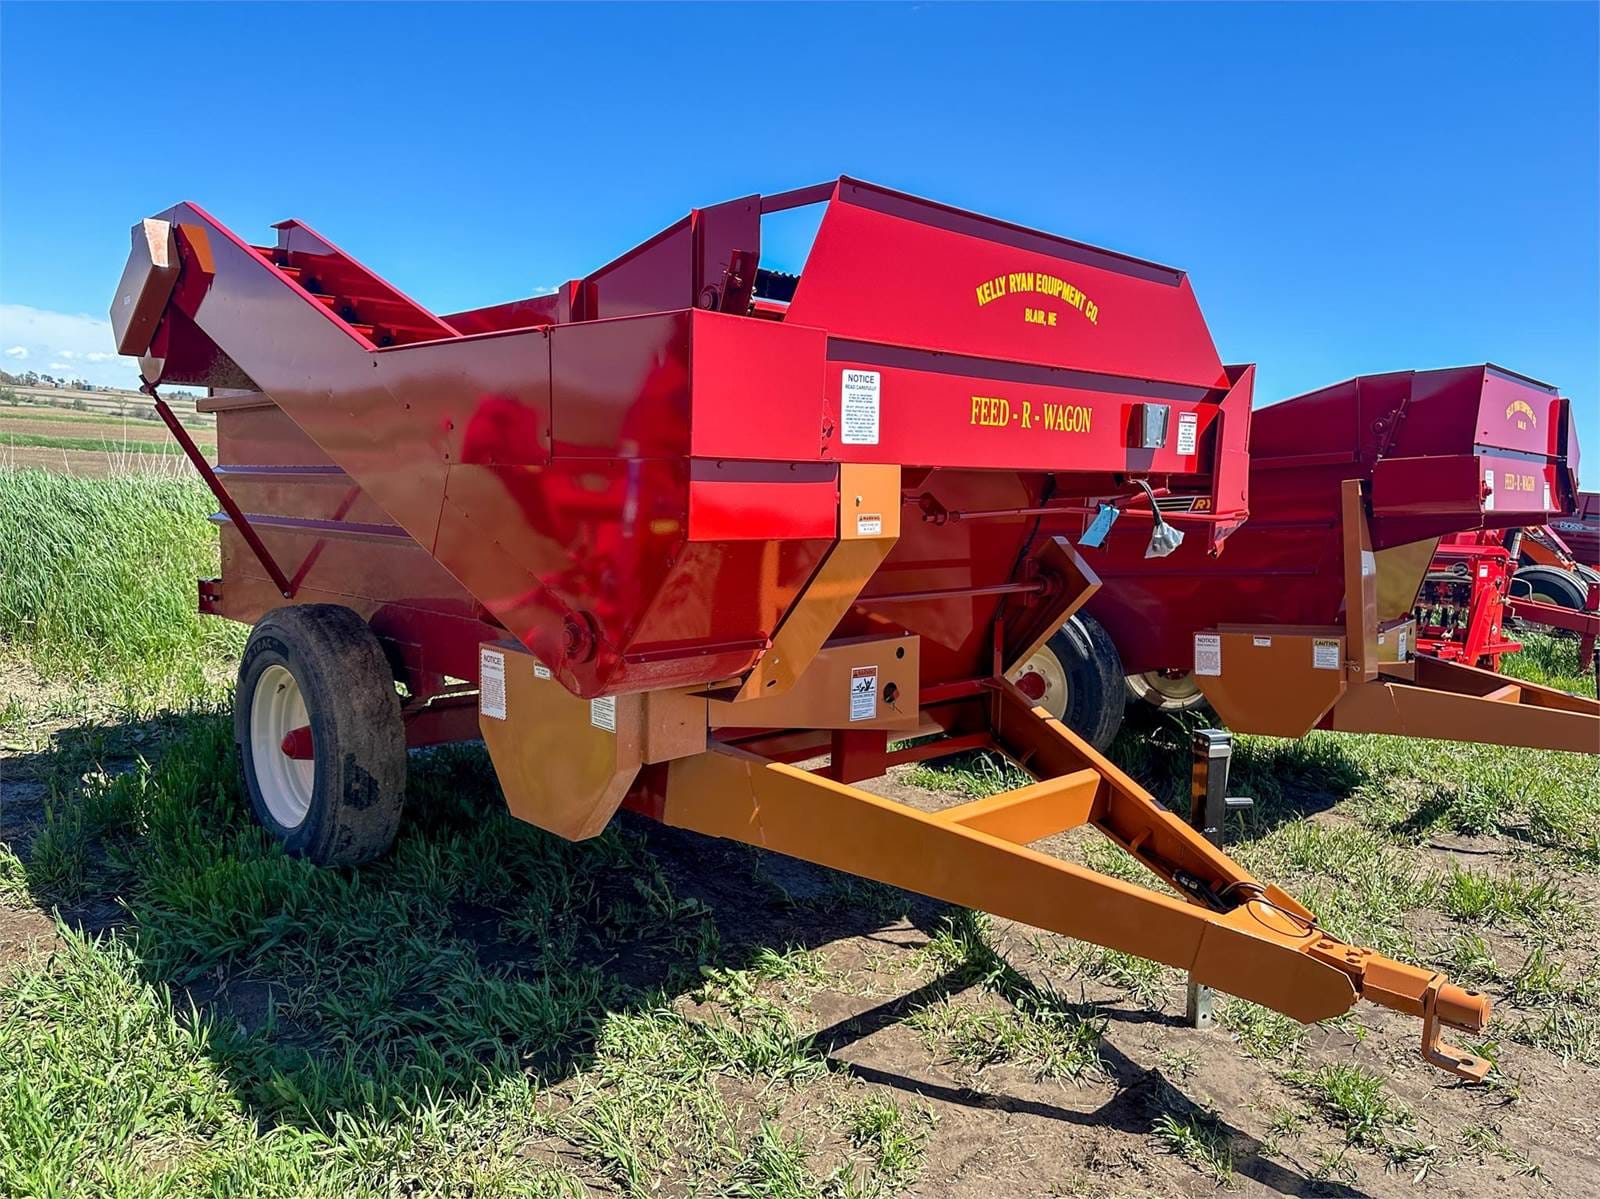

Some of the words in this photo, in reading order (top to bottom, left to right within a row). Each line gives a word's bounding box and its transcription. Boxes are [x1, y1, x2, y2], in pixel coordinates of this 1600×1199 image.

[976, 275, 1006, 306] KELLY
[1009, 272, 1034, 293] RYAN
[1036, 273, 1087, 311] EQUIPMENT
[1085, 300, 1099, 325] CO.
[1025, 308, 1046, 326] BLAIR,
[1047, 312, 1057, 326] NE
[848, 374, 875, 384] NOTICE
[970, 396, 1010, 427] FEED
[1021, 401, 1032, 429] R
[1043, 403, 1093, 433] WAGON
